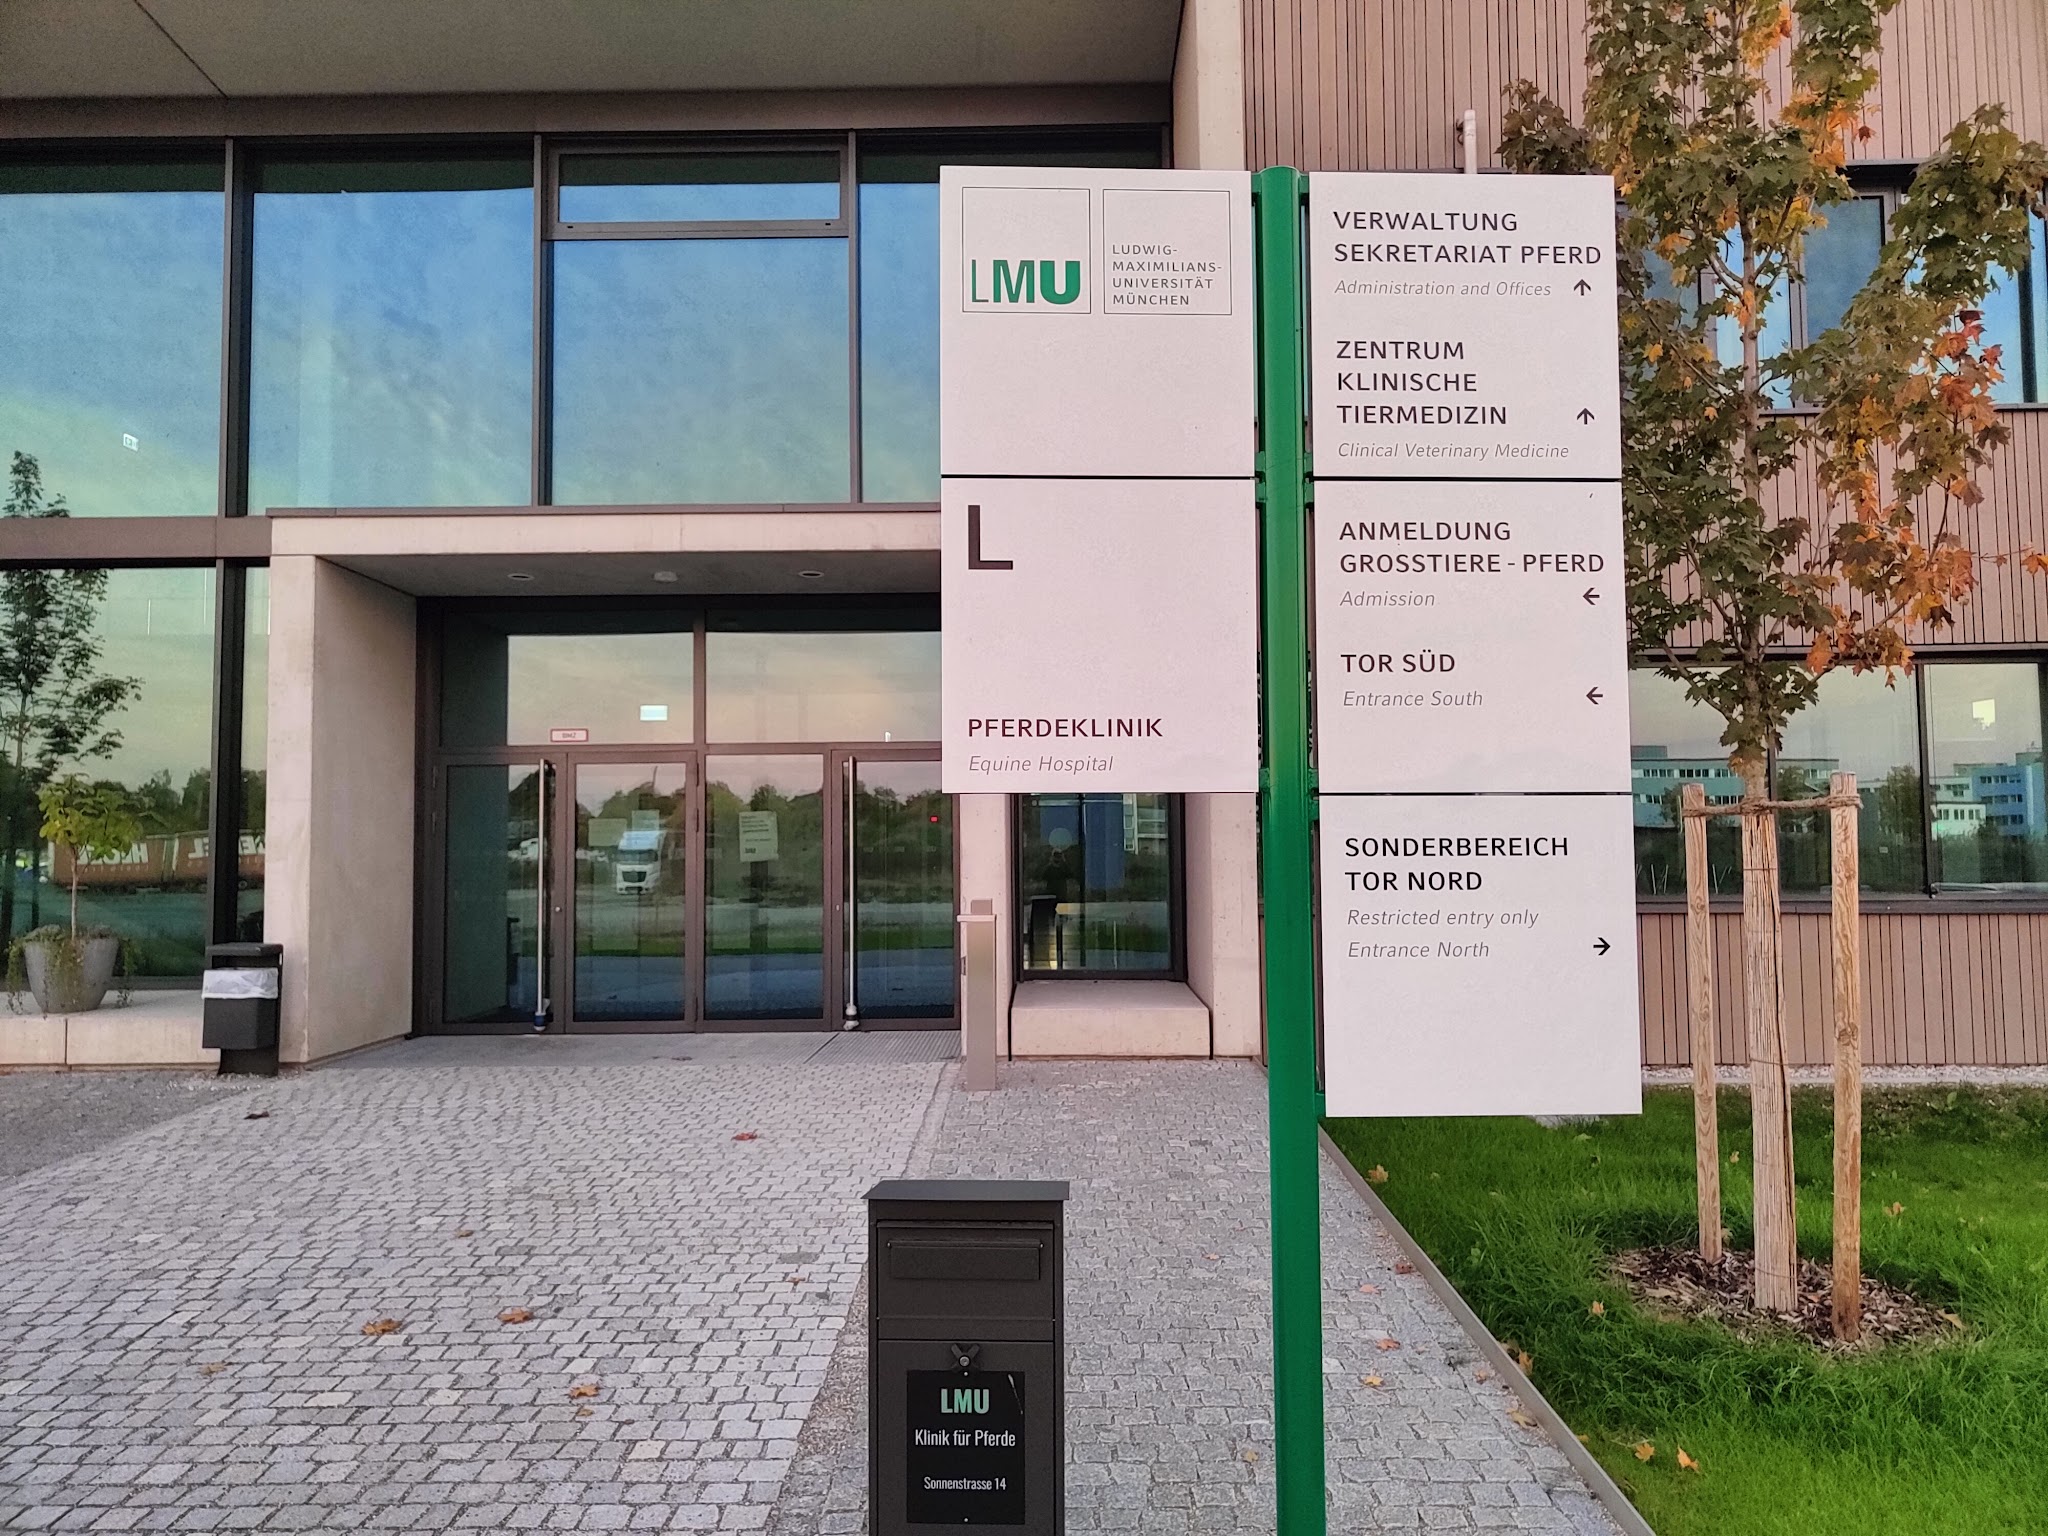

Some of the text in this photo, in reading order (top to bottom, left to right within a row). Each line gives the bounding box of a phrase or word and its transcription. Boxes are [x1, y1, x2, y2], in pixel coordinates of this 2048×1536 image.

[1332, 211, 1517, 232] VERWALTUNG
[1112, 244, 1178, 256] LUDWIG-
[1334, 243, 1601, 264] SEKRETARIAT PFERD
[1112, 260, 1222, 273] MAXIMILIANS-
[971, 259, 1081, 305] LMU
[1112, 276, 1214, 289] UNIVERSITÄT
[1334, 279, 1552, 296] Administration and Offices
[1112, 291, 1189, 306] MÜNCHEN
[1336, 340, 1464, 360] ZENTRUM
[1337, 372, 1477, 392] KLINISCHE
[1336, 405, 1507, 425] TIERMEDIZIN
[1338, 442, 1569, 462] Clinical Veterinary Medicine
[967, 504, 1014, 571] L
[1339, 521, 1511, 541] ANMELDUNG
[1523, 554, 1604, 573] PFERD
[1339, 590, 1435, 607] Admission
[1340, 647, 1455, 673] TOR SÜD
[1343, 690, 1483, 707] Entrance South
[968, 718, 1163, 738] PFERDEKLINIK
[969, 755, 1114, 776] Equine Hospital
[1345, 837, 1568, 857] SONDERBEREICH
[1344, 871, 1482, 891] TOR NORD
[1347, 908, 1539, 930] Restricted entry only
[1348, 941, 1489, 958] Entrance North
[940, 1388, 990, 1415] LMU
[915, 1428, 1016, 1447] Klinik für Pferde
[923, 1476, 1007, 1491] Sonnenstrasse 14
